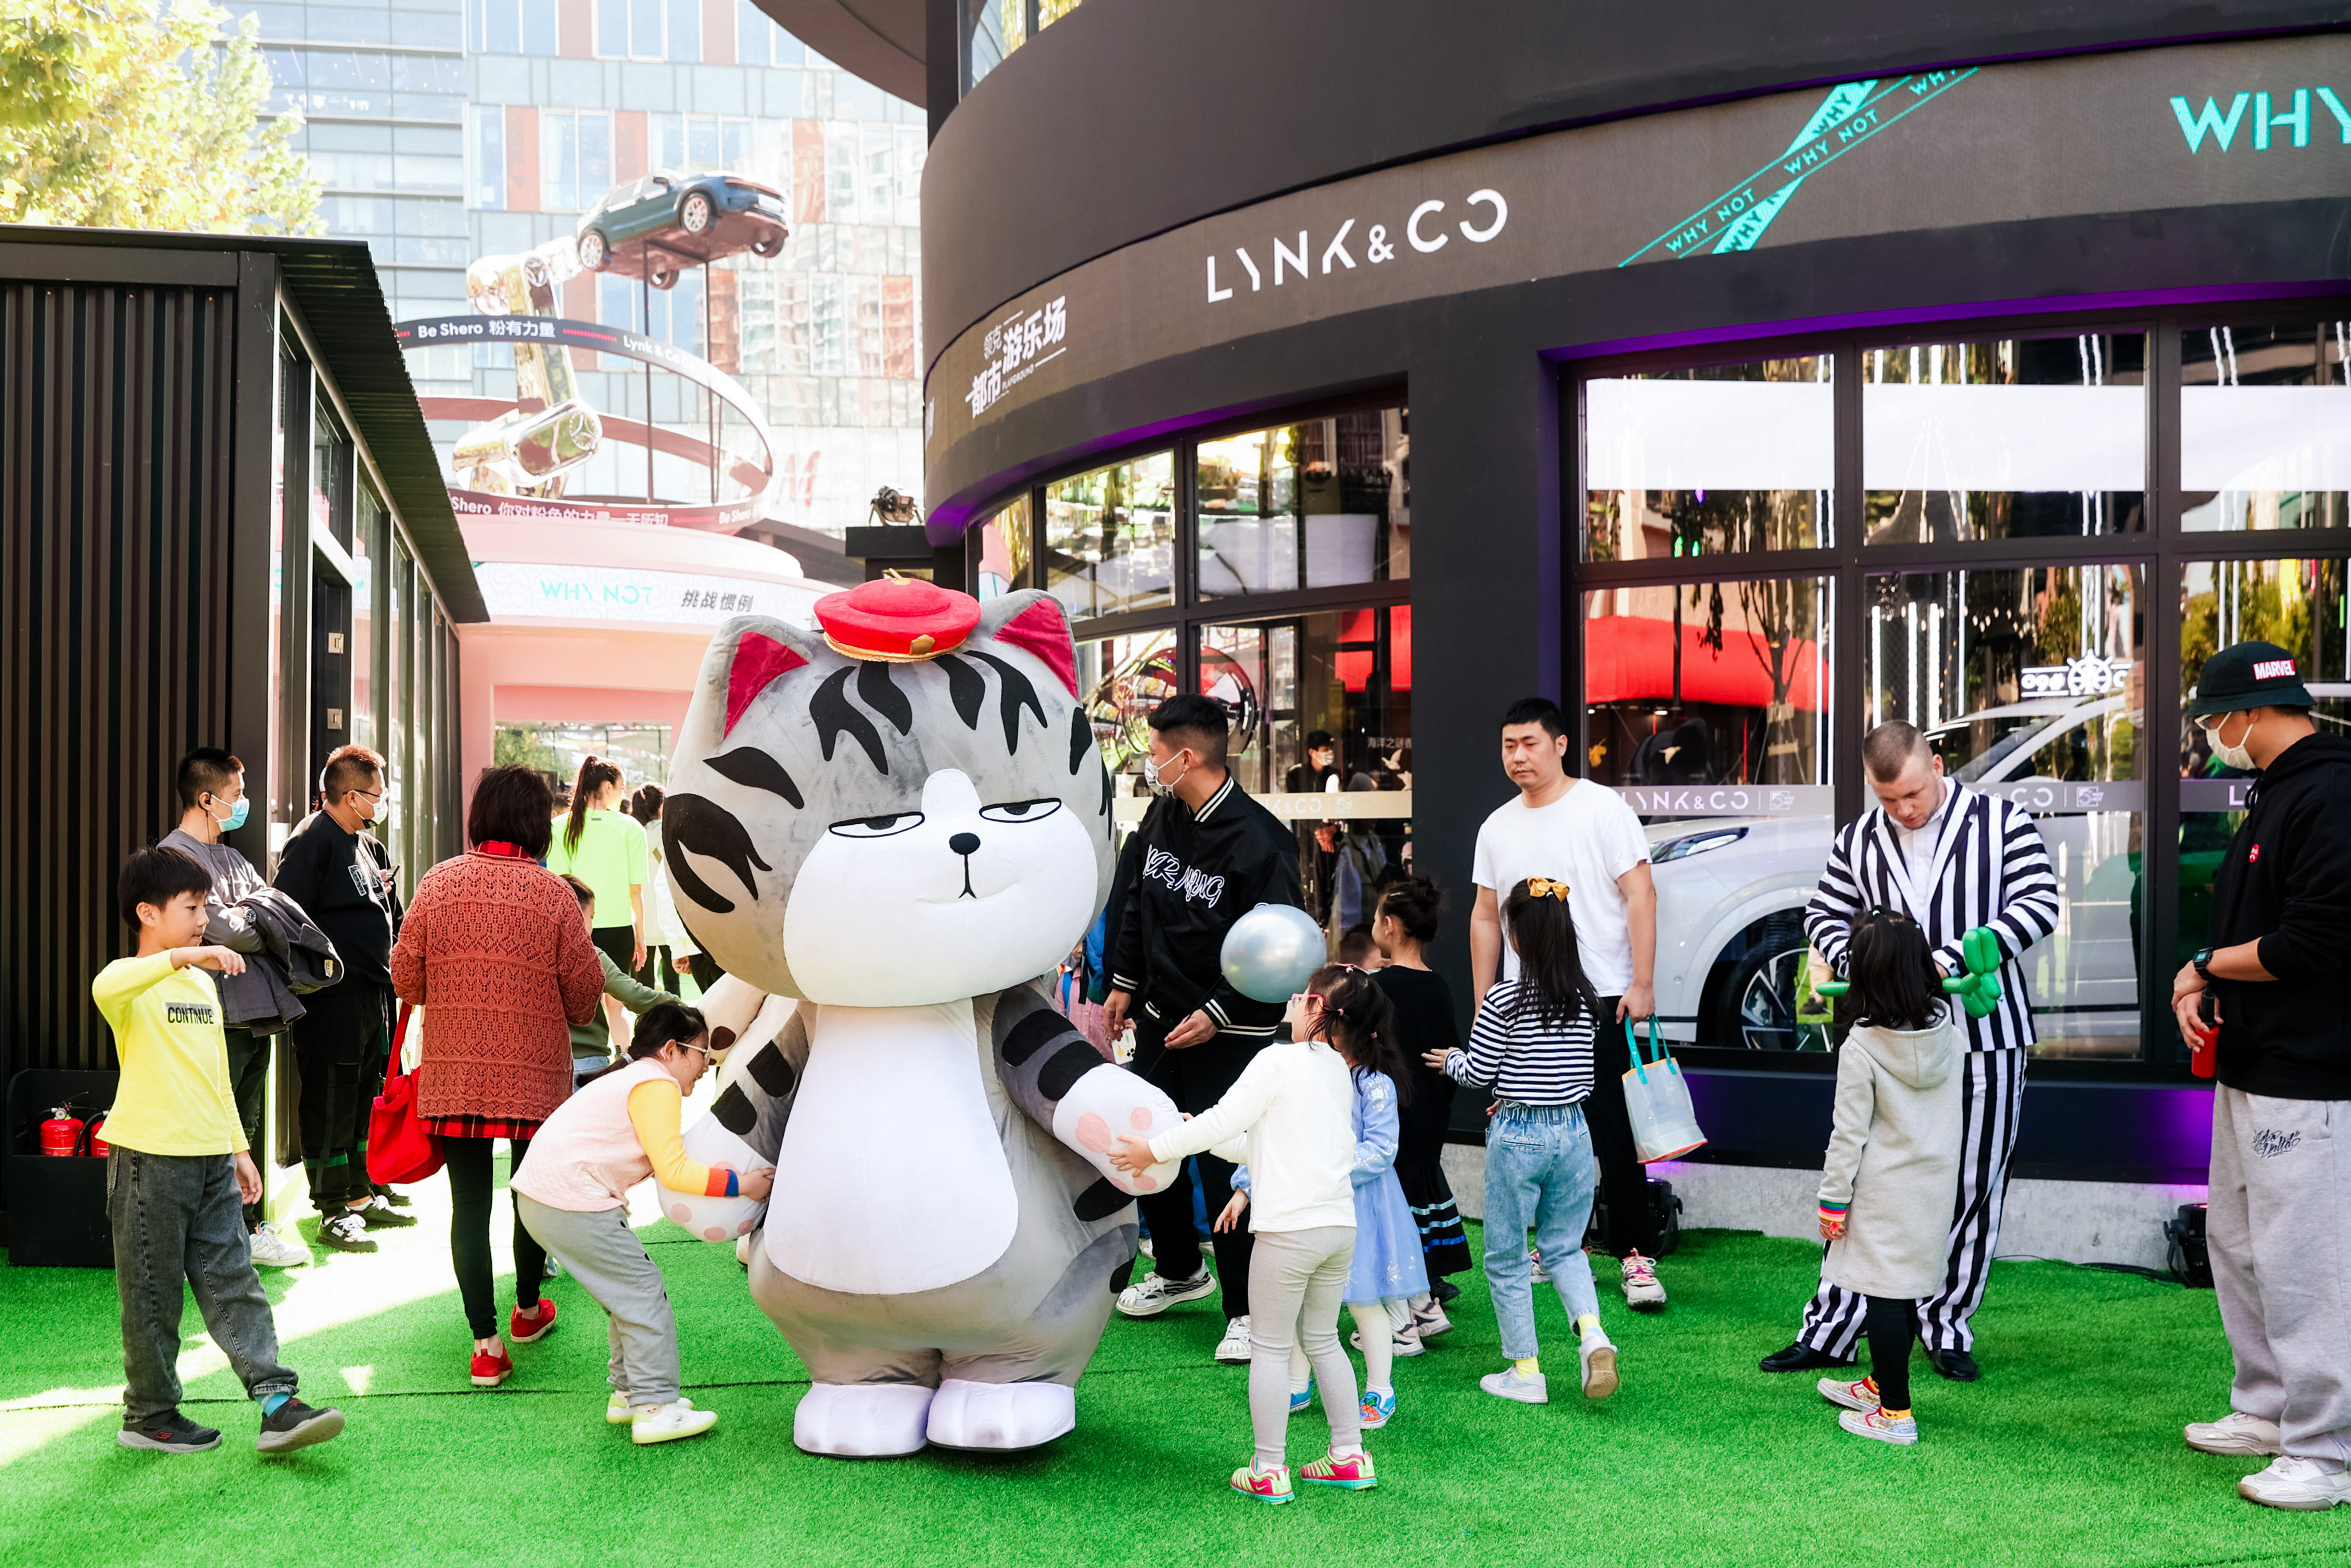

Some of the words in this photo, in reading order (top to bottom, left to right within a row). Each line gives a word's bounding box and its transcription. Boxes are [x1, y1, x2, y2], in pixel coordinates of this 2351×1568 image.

[1666, 219, 1709, 252] WHY
[1717, 188, 1756, 222] NOT
[1783, 141, 1829, 175] WHY
[1837, 108, 1879, 143] NOT
[1908, 69, 1957, 97] WH
[417, 325, 438, 339] Be
[439, 323, 484, 337] Shero
[488, 320, 556, 338] 粉有力量
[623, 335, 653, 354] Lynk
[451, 496, 492, 515] Shero
[540, 580, 593, 604] WHY
[603, 584, 654, 605] NOT
[681, 589, 754, 613] 挑战惯例
[2253, 660, 2296, 681] MARVEL
[168, 1006, 214, 1024] CONTINUE
